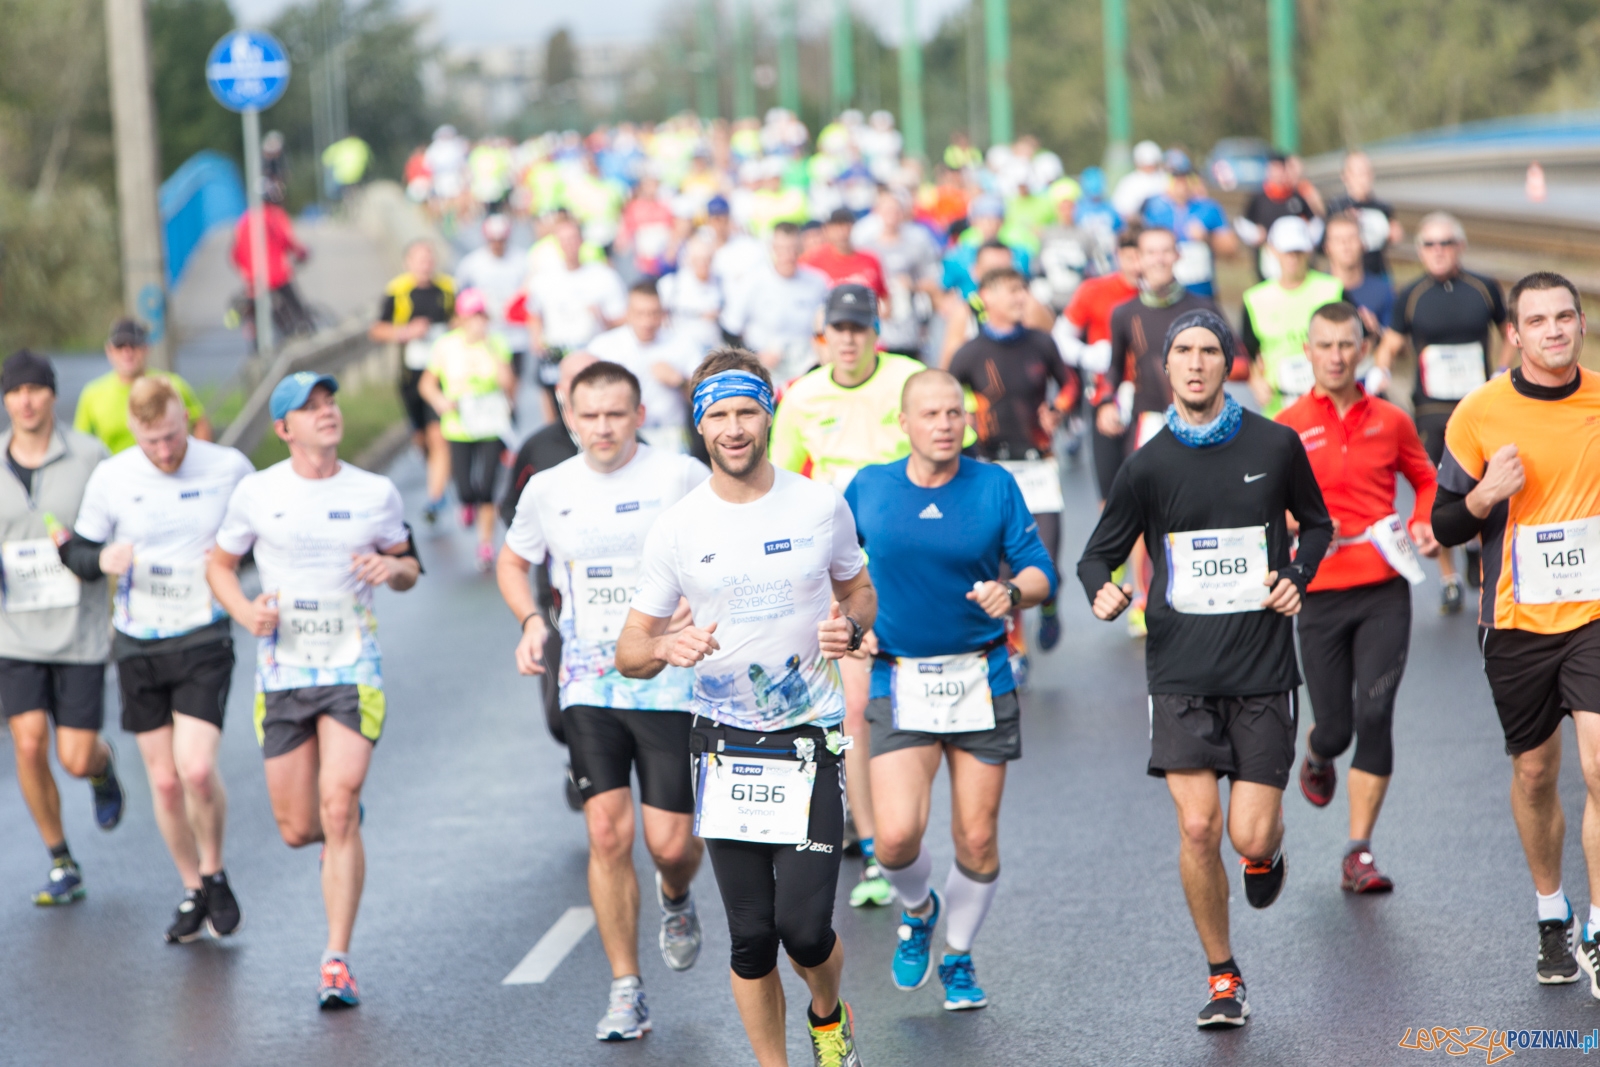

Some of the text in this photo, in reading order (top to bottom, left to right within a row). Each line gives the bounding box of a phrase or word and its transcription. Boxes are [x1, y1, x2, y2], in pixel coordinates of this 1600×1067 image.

[766, 541, 790, 552] 17.PKO
[700, 553, 716, 563] 4F
[1543, 548, 1586, 568] 1461
[1192, 558, 1247, 577] 5068
[722, 573, 751, 587] SIŁA
[1552, 571, 1582, 580] Marcin
[733, 578, 793, 597] ODWAGA
[728, 589, 794, 610] SZYBKOŚĆ
[291, 618, 343, 635] 5043
[924, 681, 965, 698] 1401
[734, 765, 761, 774] 17.PKO
[731, 783, 786, 803] 6136
[738, 806, 775, 817] Szymon
[809, 842, 834, 853] asics
